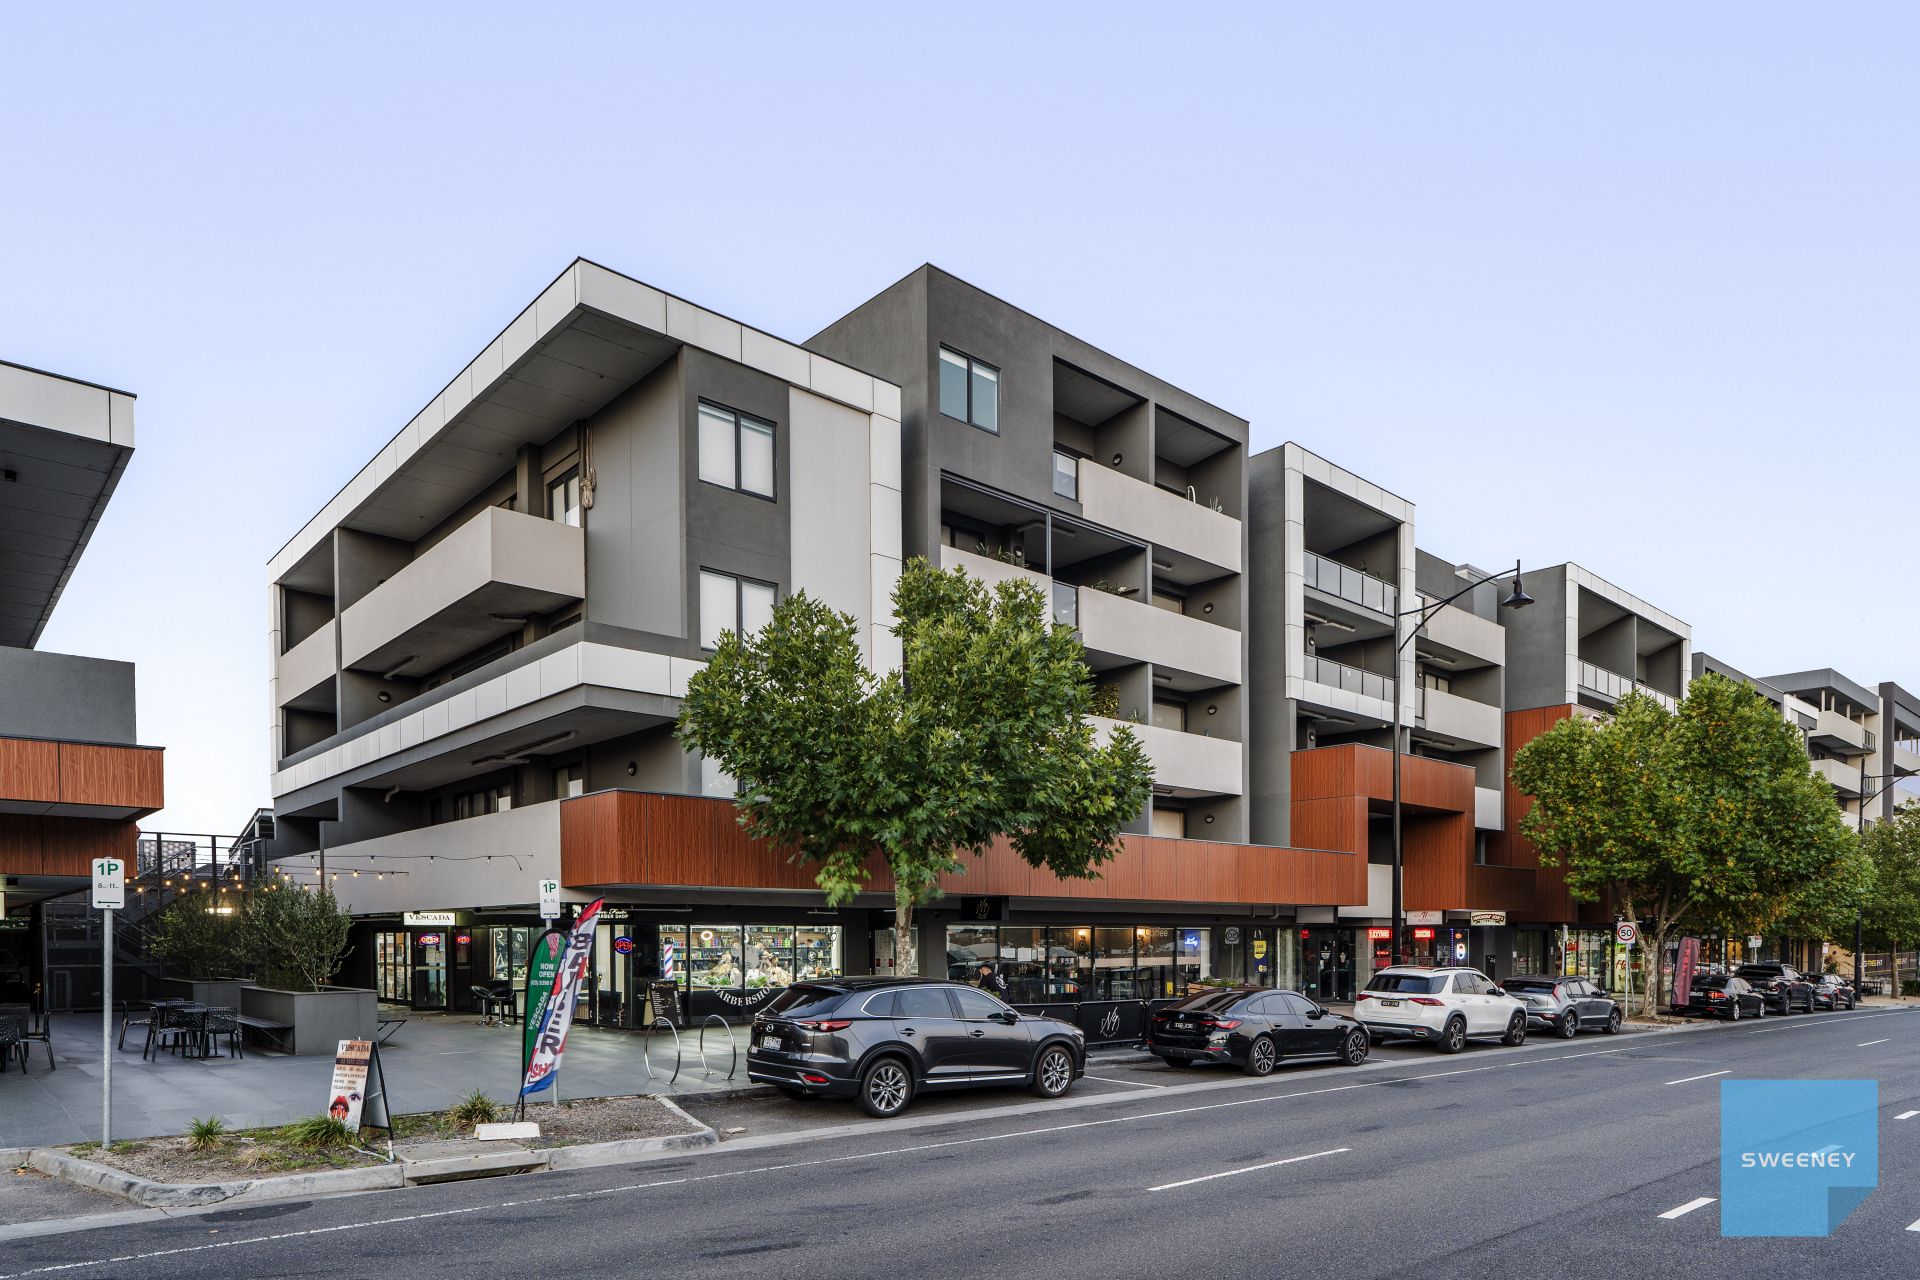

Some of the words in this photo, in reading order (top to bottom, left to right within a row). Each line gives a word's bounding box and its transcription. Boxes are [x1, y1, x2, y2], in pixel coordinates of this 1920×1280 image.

[97, 862, 119, 876] 1P
[543, 883, 556, 893] 1P
[1621, 929, 1632, 937] 50
[614, 941, 633, 951] OPEN
[711, 986, 771, 1007] BARBERSHO
[528, 991, 548, 1030] VESCADA
